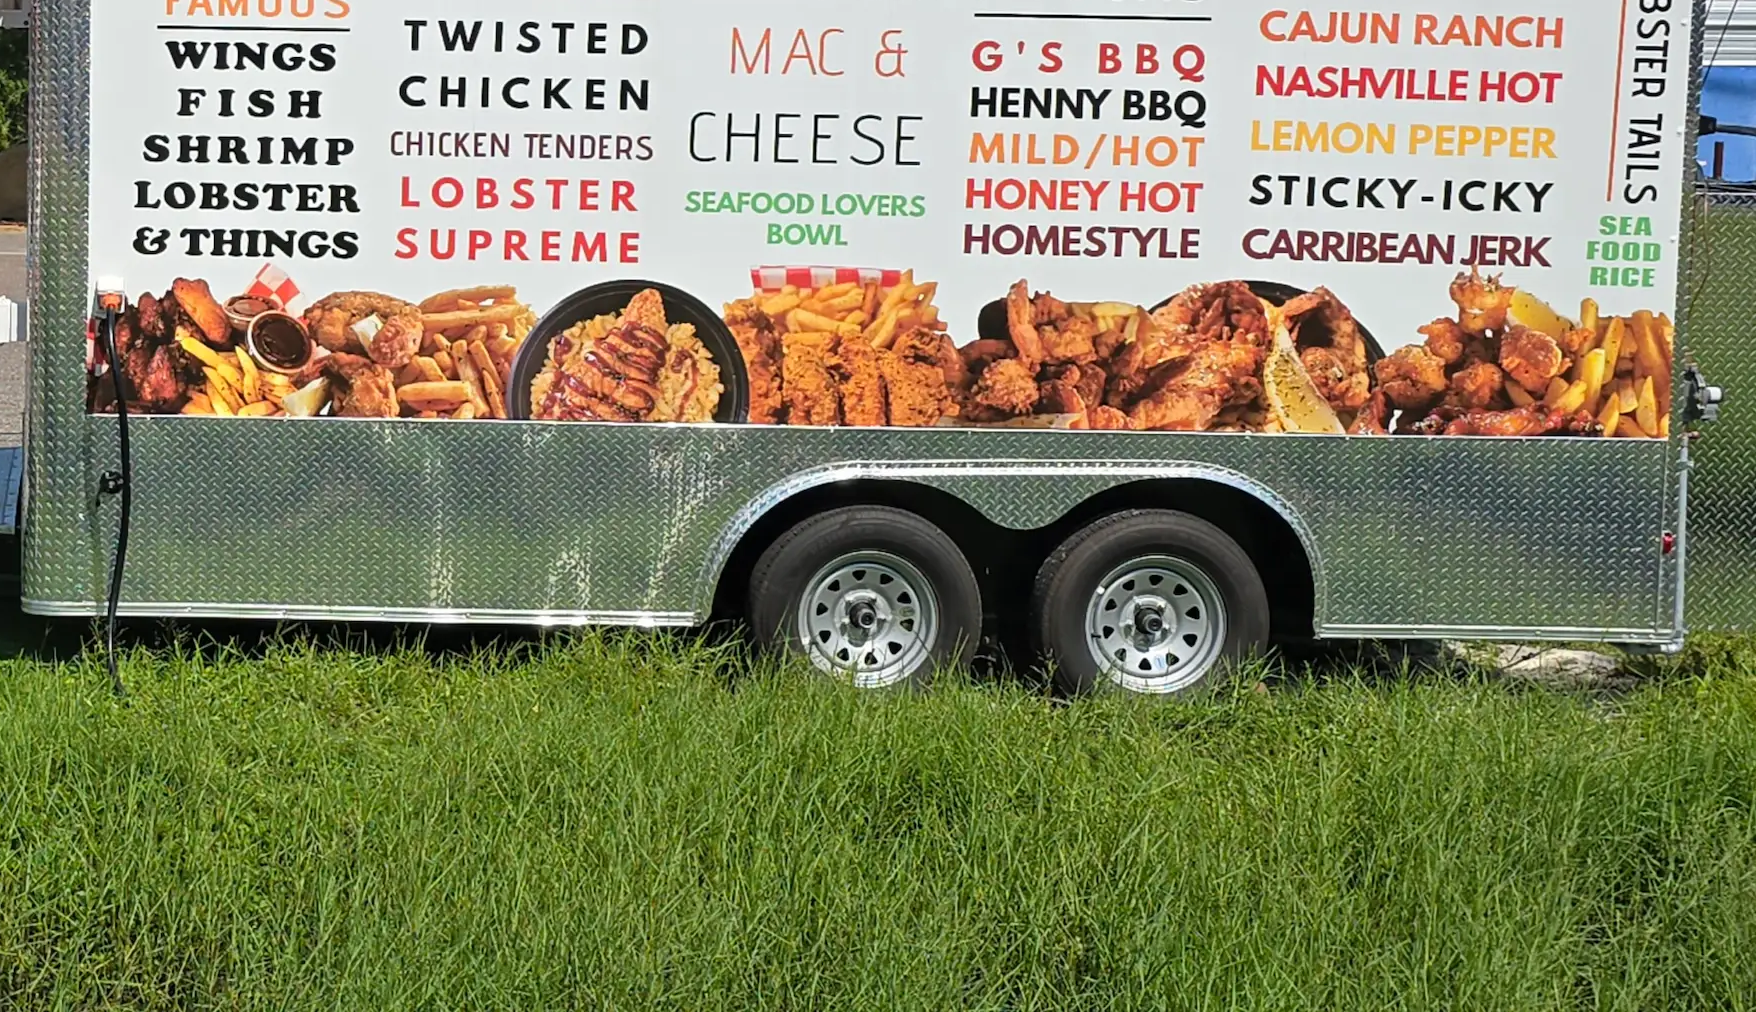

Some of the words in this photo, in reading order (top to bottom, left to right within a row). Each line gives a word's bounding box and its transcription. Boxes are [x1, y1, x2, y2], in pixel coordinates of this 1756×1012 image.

[404, 20, 648, 54] TWISTED
[1260, 10, 1400, 44] CAJUN
[1414, 14, 1563, 48] RANCH
[165, 41, 336, 71] WINGS
[731, 28, 844, 76] MAC
[875, 30, 908, 77] &
[972, 41, 1062, 73] G'S
[1098, 43, 1205, 82] BBQ
[399, 76, 649, 111] CHICKEN
[1256, 65, 1468, 101] NASHVILLE
[1479, 71, 1563, 103] HOT
[177, 88, 322, 118] FISH
[971, 87, 1112, 119] HENNY
[1123, 90, 1206, 128] BBQ
[143, 135, 354, 165] SHRIMP
[391, 131, 509, 157] CHICKEN
[524, 134, 653, 160] TENDERS
[690, 112, 923, 165] CHEESE
[969, 133, 1204, 169] MILD/HOT
[1251, 120, 1395, 154] LEMON
[1409, 124, 1557, 158] PEPPER
[1624, 113, 1663, 204] TAILS
[134, 181, 360, 213] LOBSTER
[401, 176, 637, 211] LOBSTER
[685, 191, 814, 214] SEAFOOD
[822, 194, 925, 217] LOVERS
[966, 178, 1110, 211] HONEY
[1120, 182, 1203, 212] HOT
[1249, 175, 1554, 212] STICKY-ICKY
[133, 227, 170, 255] &
[180, 228, 358, 259] THINGS
[768, 224, 847, 245] BOWL
[964, 224, 1200, 258] HOMESTYLE
[1600, 216, 1652, 236] SEA
[395, 228, 639, 263] SUPREME
[1242, 229, 1455, 264] CARRIBEAN
[1460, 235, 1551, 267] JERK
[1587, 241, 1661, 261] FOOD
[1590, 267, 1655, 287] RICE
